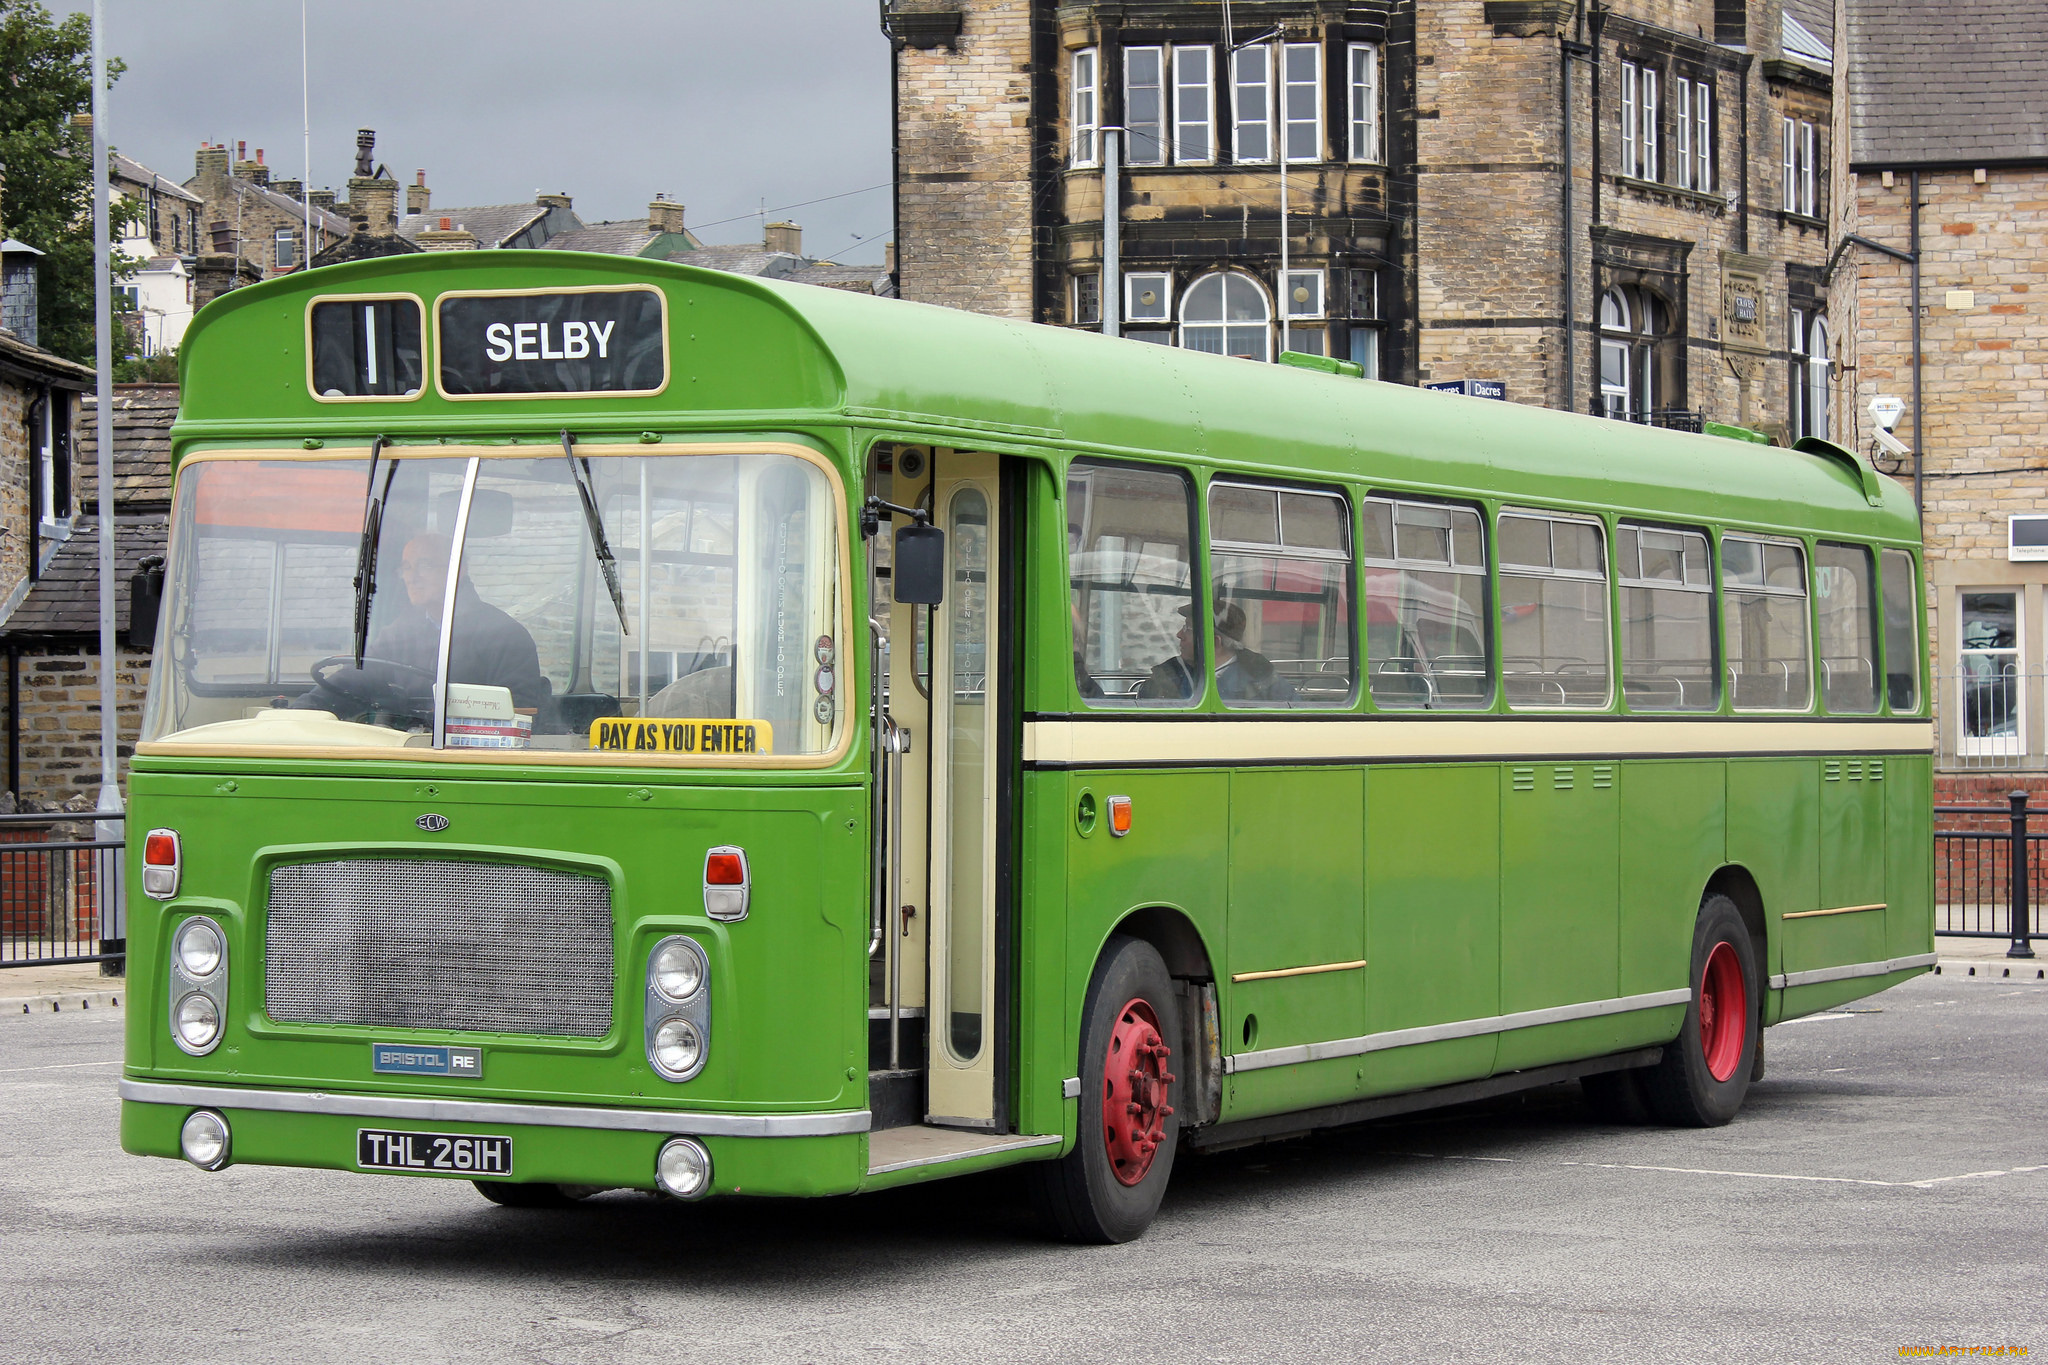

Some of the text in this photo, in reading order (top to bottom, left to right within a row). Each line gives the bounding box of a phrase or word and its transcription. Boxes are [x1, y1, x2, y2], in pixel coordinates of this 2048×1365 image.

[486, 320, 615, 362] SELBY
[1475, 383, 1501, 397] Dacres
[964, 571, 972, 585] TO
[964, 589, 972, 618] OPEN
[776, 611, 785, 697] PUSH TO OPEN
[600, 723, 756, 753] PAY AS YOU ENTER
[419, 815, 446, 829] ECW
[380, 1051, 475, 1068] BRISTOL RE
[367, 1134, 502, 1171] THL 261H
